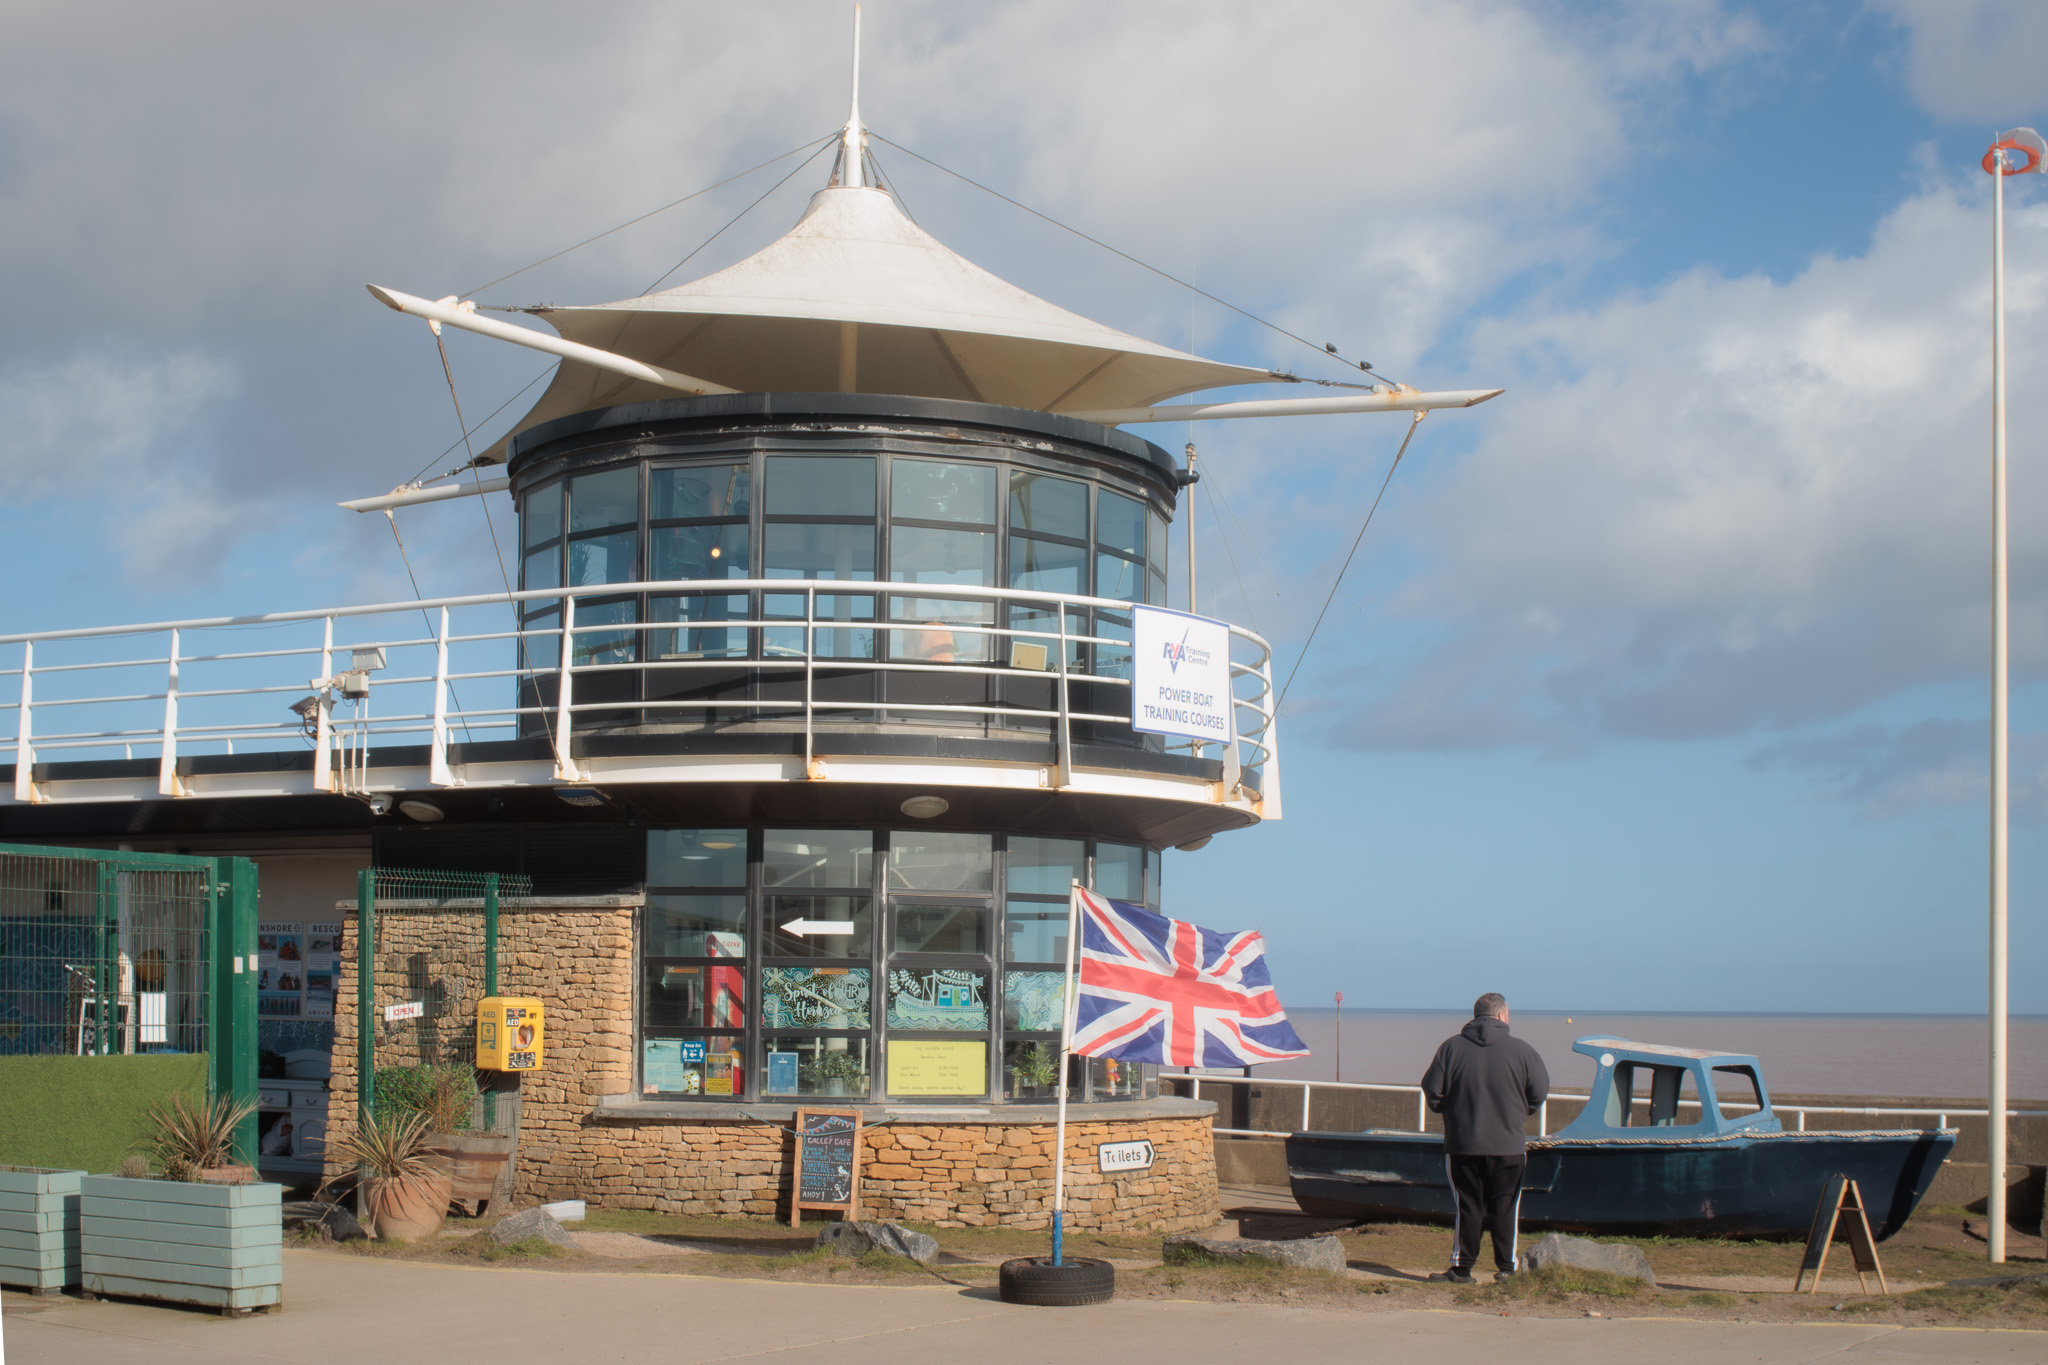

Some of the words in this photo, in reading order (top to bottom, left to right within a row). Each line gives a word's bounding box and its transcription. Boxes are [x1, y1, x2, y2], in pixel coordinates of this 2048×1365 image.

[1163, 642, 1186, 662] RYA
[1186, 646, 1210, 659] Training
[1188, 655, 1208, 666] Centre
[1159, 686, 1191, 703] POWER
[1193, 692, 1214, 708] BOAT
[1144, 705, 1188, 723] TRAINING
[1190, 712, 1224, 730] COURSES
[722, 940, 741, 948] DRINK
[784, 981, 823, 1003] Spirt
[822, 982, 835, 1000] of
[844, 985, 858, 999] HR
[394, 1006, 414, 1016] OPEN
[506, 1018, 519, 1026] AED
[835, 1138, 851, 1146] CAFE
